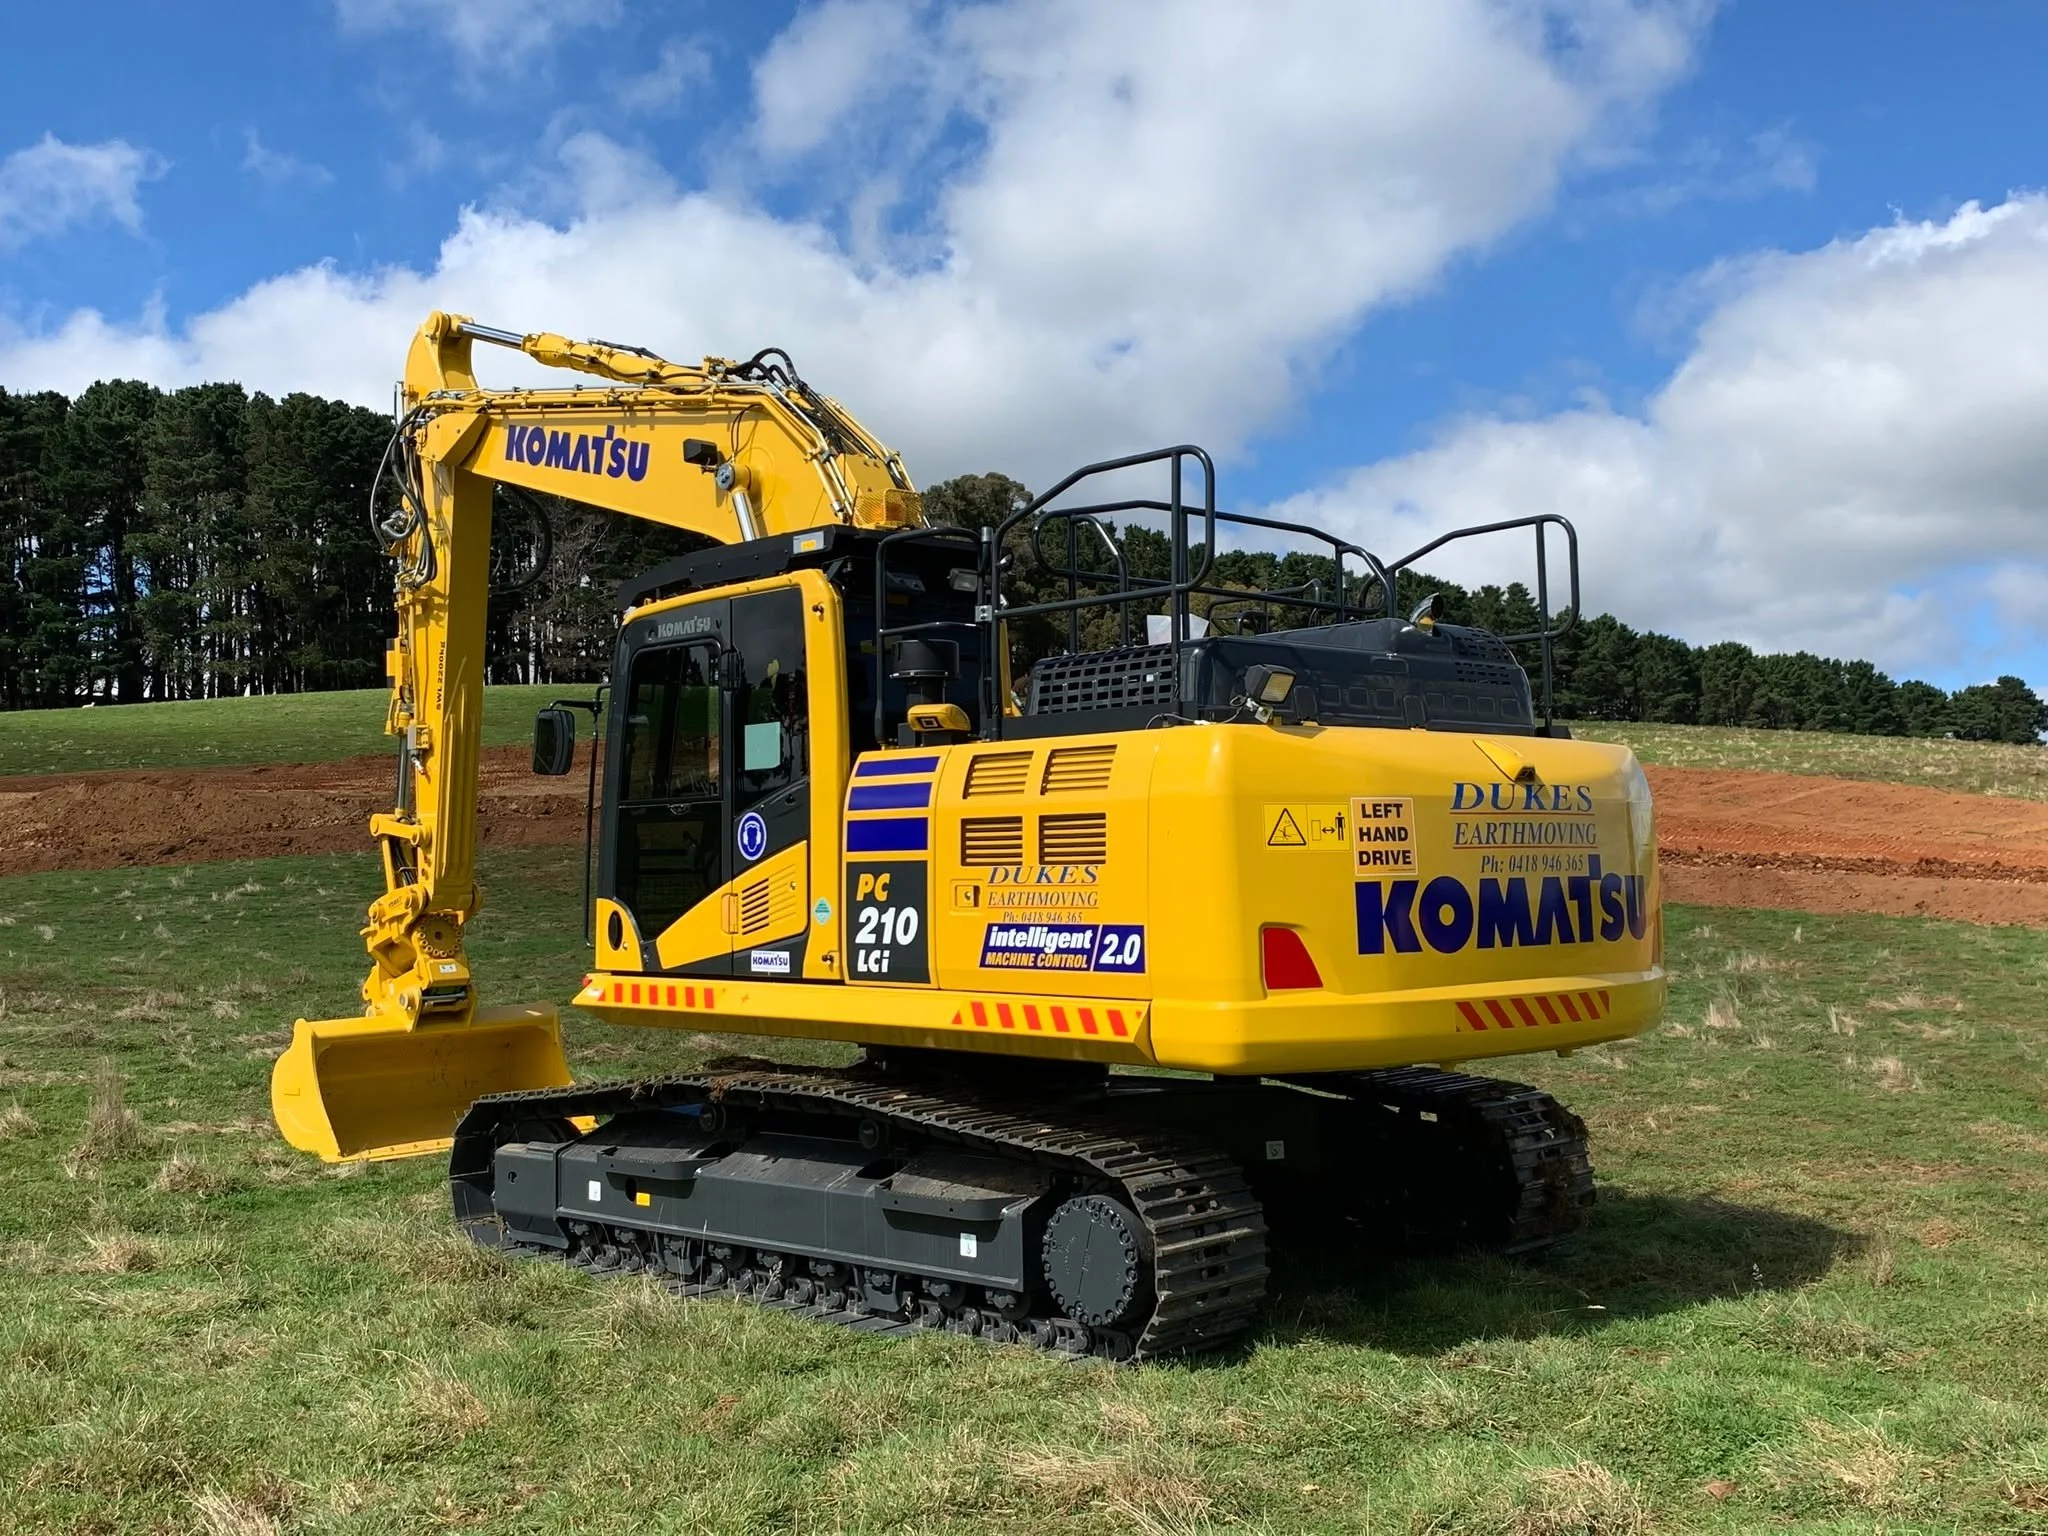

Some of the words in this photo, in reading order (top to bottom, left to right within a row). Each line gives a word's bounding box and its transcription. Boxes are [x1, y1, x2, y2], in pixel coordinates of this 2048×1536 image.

[505, 424, 650, 482] KOMATSU
[658, 616, 711, 638] KOMATSU
[1450, 782, 1593, 812] DUKES
[1361, 803, 1403, 818] LEFT
[1358, 826, 1408, 842] HAND
[1454, 822, 1597, 845] EARTHMOVING
[1358, 850, 1412, 866] DRIVE
[1480, 855, 1504, 873] Ph:
[1508, 854, 1538, 873] 0418
[1542, 854, 1562, 873] 946
[1565, 854, 1584, 872] 365
[988, 865, 1099, 884] DUKES
[856, 872, 891, 902] PC
[988, 891, 1098, 906] EARTHMOVING
[1354, 854, 1647, 954] KOMATSU
[855, 906, 919, 946] 210
[1002, 911, 1018, 923] Ph:
[1021, 911, 1043, 923] 0418
[1046, 911, 1063, 923] 946
[1066, 911, 1082, 923] 365
[988, 926, 1093, 953] intelligent
[1099, 933, 1141, 966] 2.0
[752, 954, 788, 966] KOMATSU
[857, 949, 890, 973] LCi
[985, 952, 1036, 967] MACHINE
[1036, 953, 1088, 968] CONTROL
